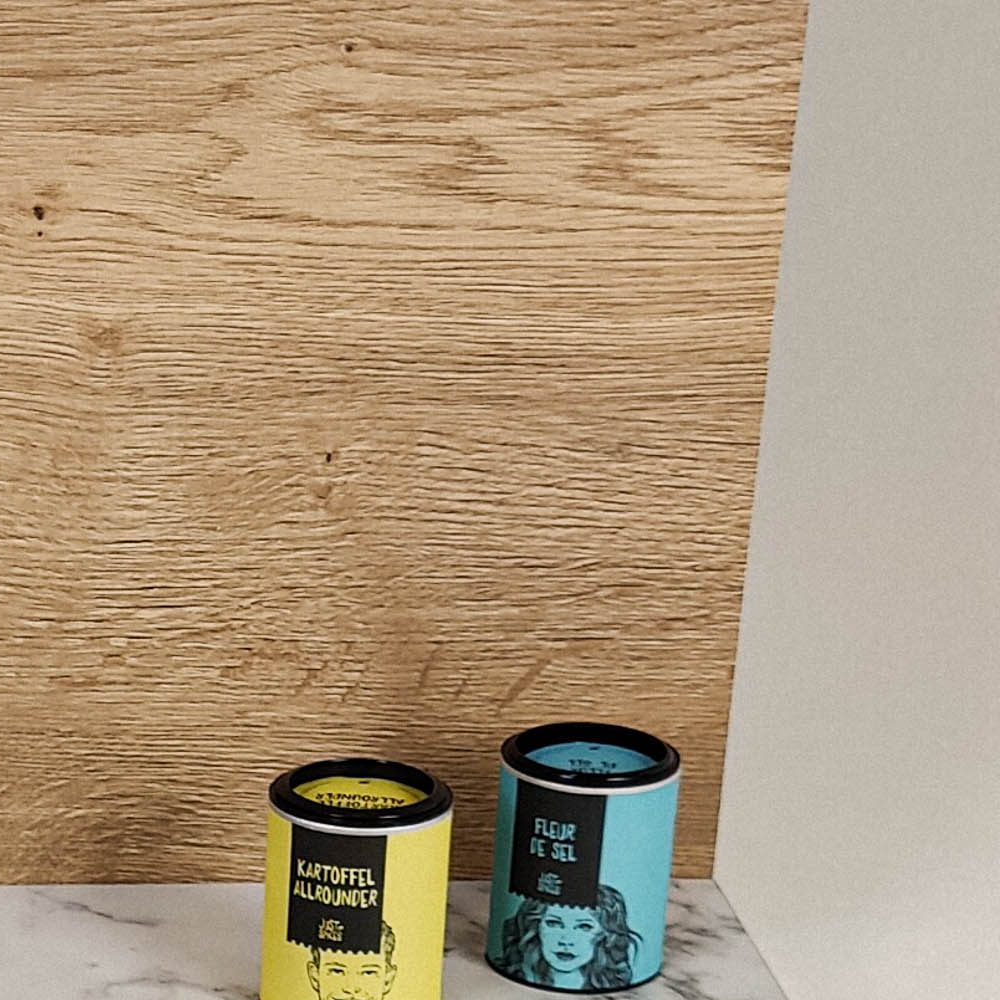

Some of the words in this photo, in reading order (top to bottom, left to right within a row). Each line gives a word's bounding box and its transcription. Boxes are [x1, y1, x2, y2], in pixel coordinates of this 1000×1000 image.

[534, 816, 577, 842] FLEUR
[529, 836, 546, 858] DE
[550, 841, 578, 863] SEL
[296, 857, 376, 888] KARTOFFEL
[292, 879, 379, 909] ALLROUNDER
